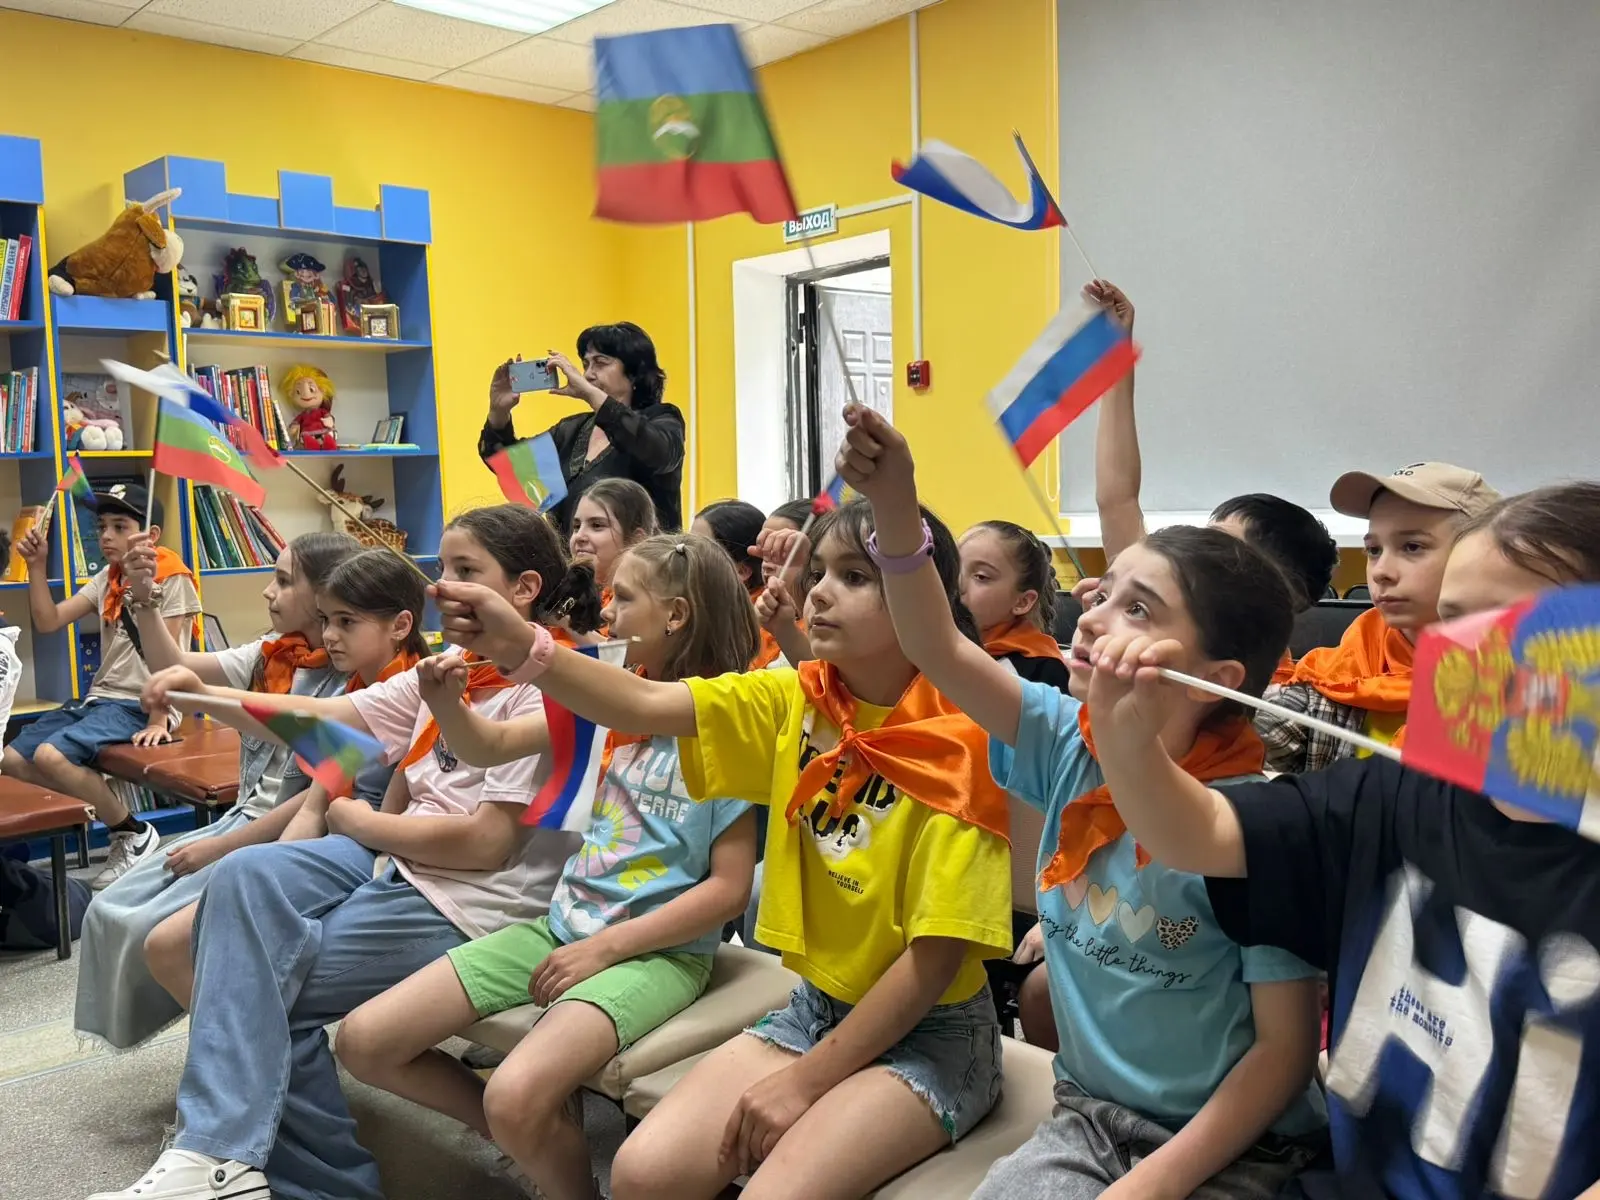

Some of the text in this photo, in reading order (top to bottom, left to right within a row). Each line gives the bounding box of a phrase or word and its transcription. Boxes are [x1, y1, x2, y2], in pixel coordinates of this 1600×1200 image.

[789, 211, 830, 233] ВЫХОД
[828, 870, 860, 887] BELIEVE IN
[836, 880, 864, 895] YOURSELF
[1039, 910, 1192, 989] joy the little things
[1390, 995, 1453, 1047] the moments
[1399, 986, 1446, 1029] these are
